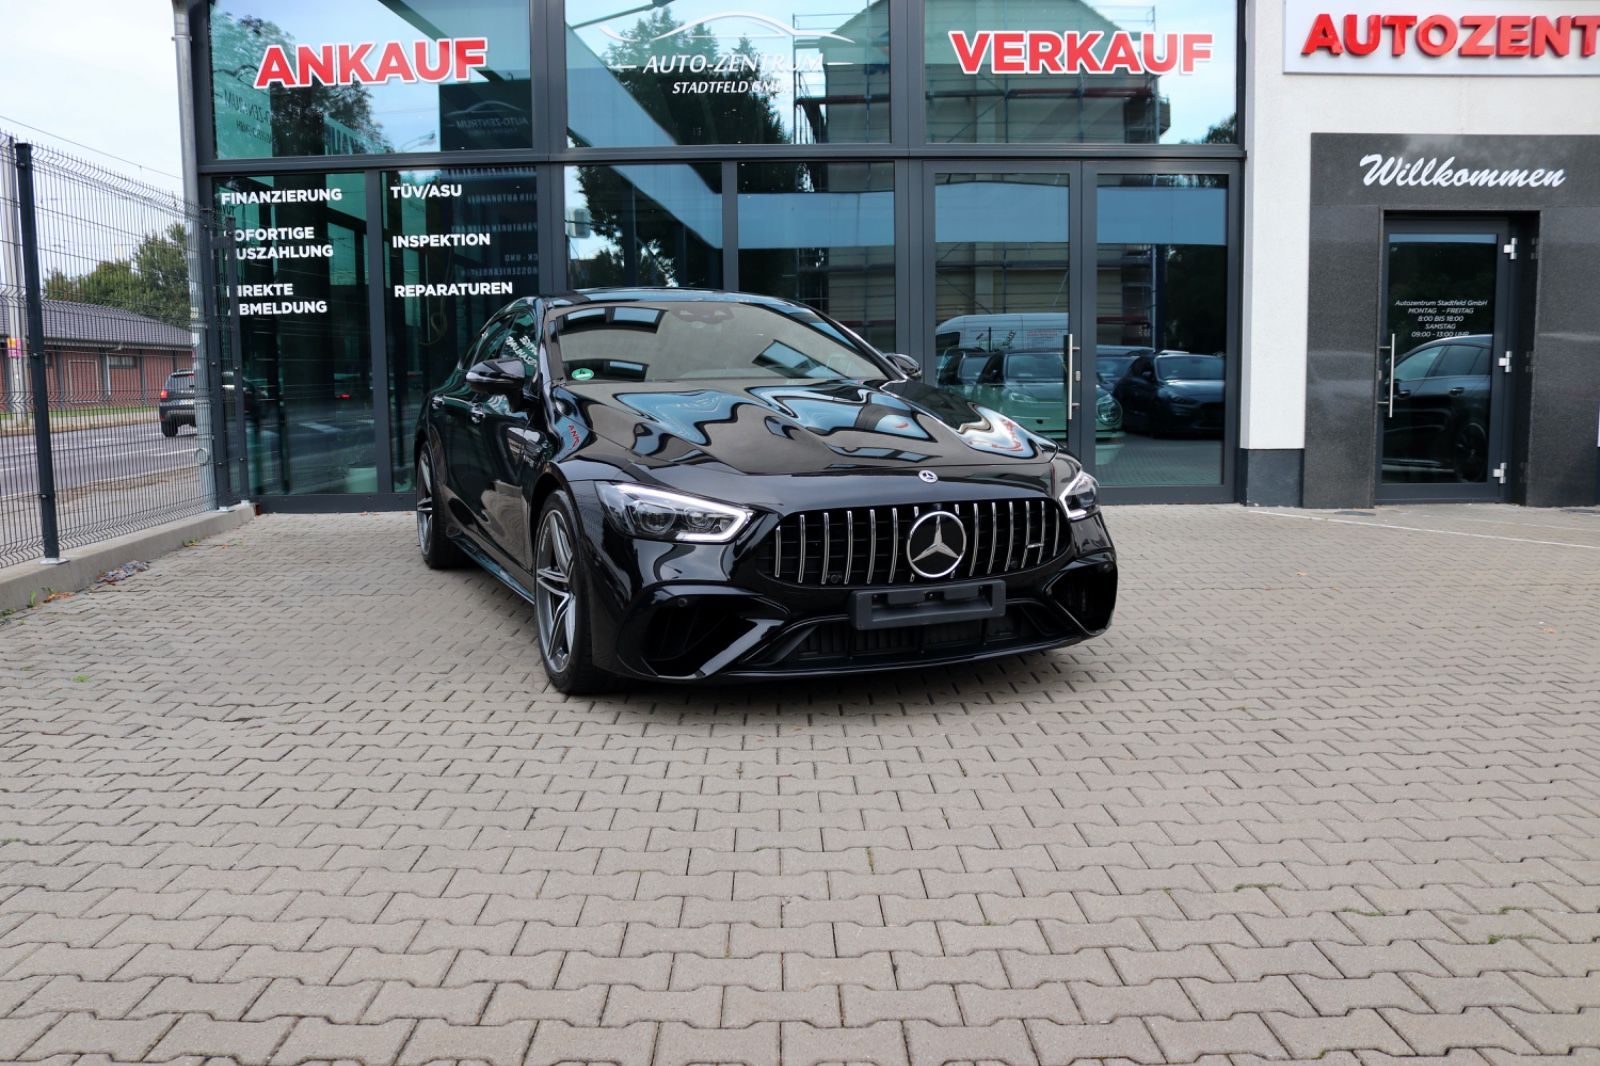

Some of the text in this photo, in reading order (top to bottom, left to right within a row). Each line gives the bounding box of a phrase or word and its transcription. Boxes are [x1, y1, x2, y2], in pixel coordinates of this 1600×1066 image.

[949, 29, 1214, 76] VERKAUF
[254, 37, 488, 89] ANKAUF
[643, 53, 824, 74] AUTO-ZENTRUM
[672, 81, 748, 94] STADTFELD
[1359, 153, 1566, 188] Willkommen
[221, 188, 343, 205] FINANZIERUNG
[390, 183, 463, 200] TÜV/ASU
[224, 227, 315, 242] OFORTIGE
[392, 233, 491, 249] INSPEKTION
[225, 245, 334, 260] USZAHLUNG
[227, 283, 294, 298] IREKTE
[394, 281, 513, 298] REPARATUREN
[228, 301, 328, 316] BMELDUNG
